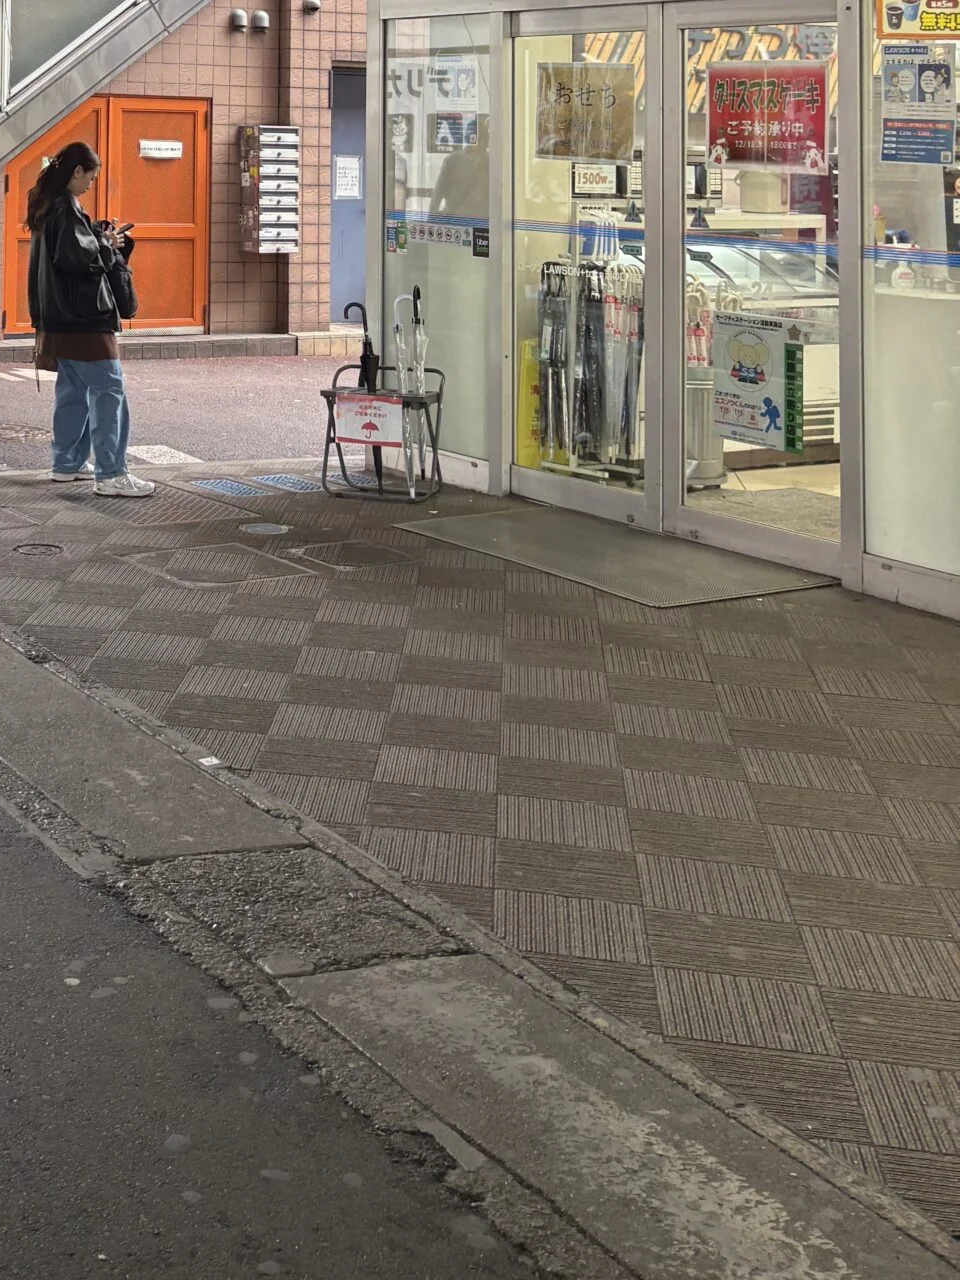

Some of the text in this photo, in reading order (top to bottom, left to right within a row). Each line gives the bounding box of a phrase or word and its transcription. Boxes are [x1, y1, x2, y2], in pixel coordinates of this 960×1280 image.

[920, 11, 960, 31] 無料
[554, 81, 616, 109] おせち
[713, 77, 821, 113] クリスマスケーキ
[727, 120, 804, 137] ご予約承り中
[476, 238, 488, 246] Uber
